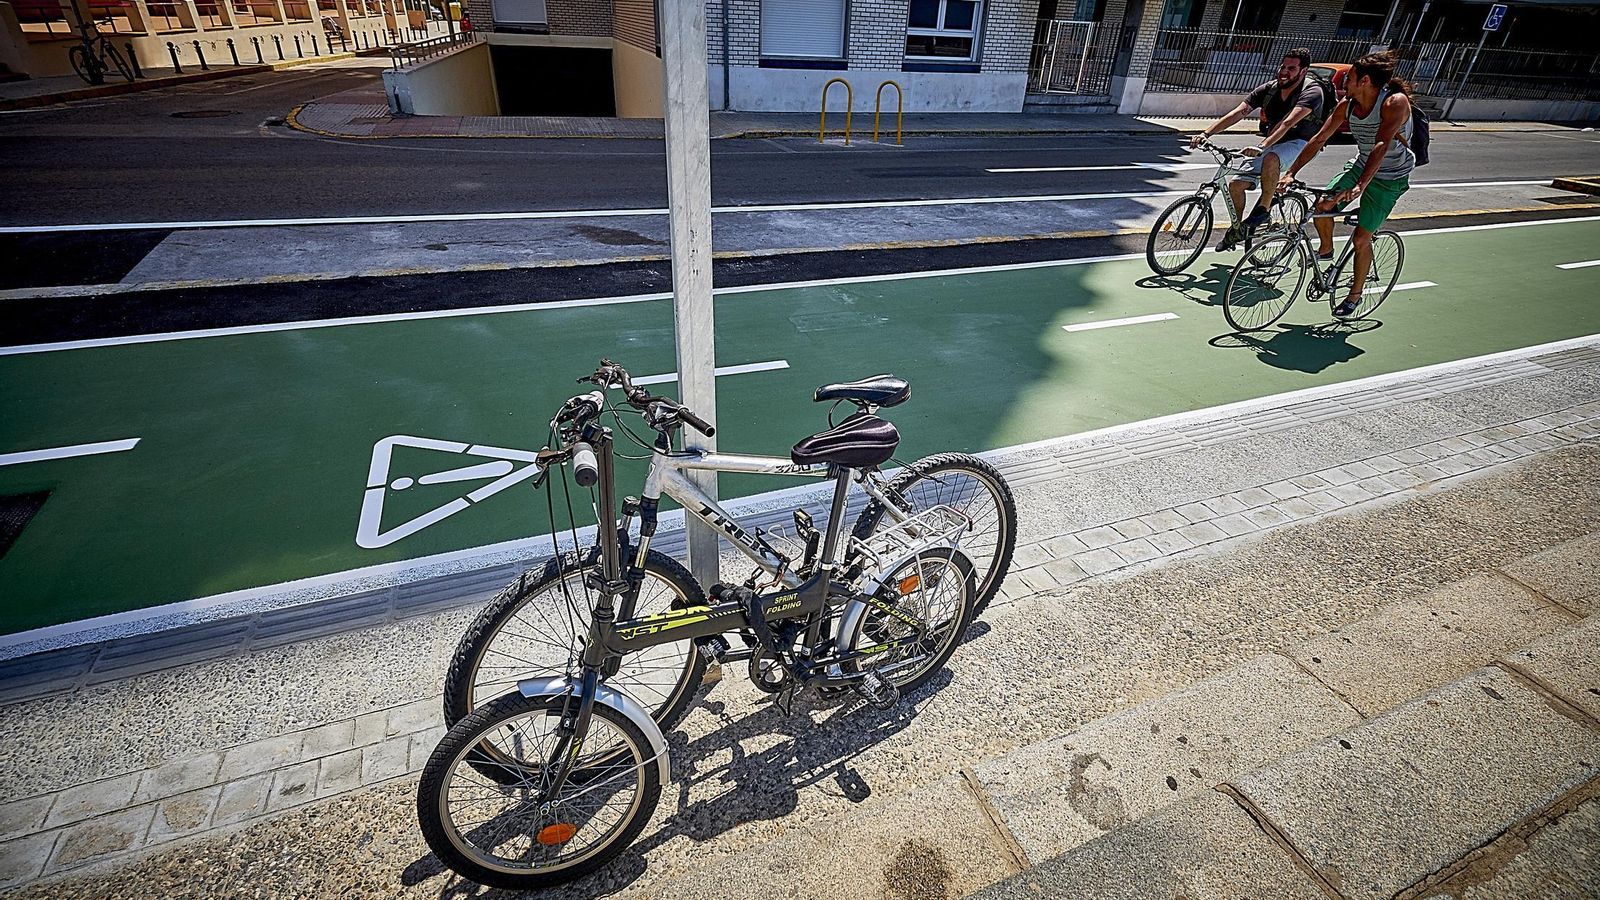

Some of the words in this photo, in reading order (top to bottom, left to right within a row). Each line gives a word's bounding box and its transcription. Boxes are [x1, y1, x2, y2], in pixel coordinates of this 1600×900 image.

[699, 501, 772, 560] TREK
[766, 600, 802, 615] FOLDING
[774, 592, 799, 605] SPRINT
[868, 597, 919, 626] FOLDING
[616, 622, 669, 640] WST
